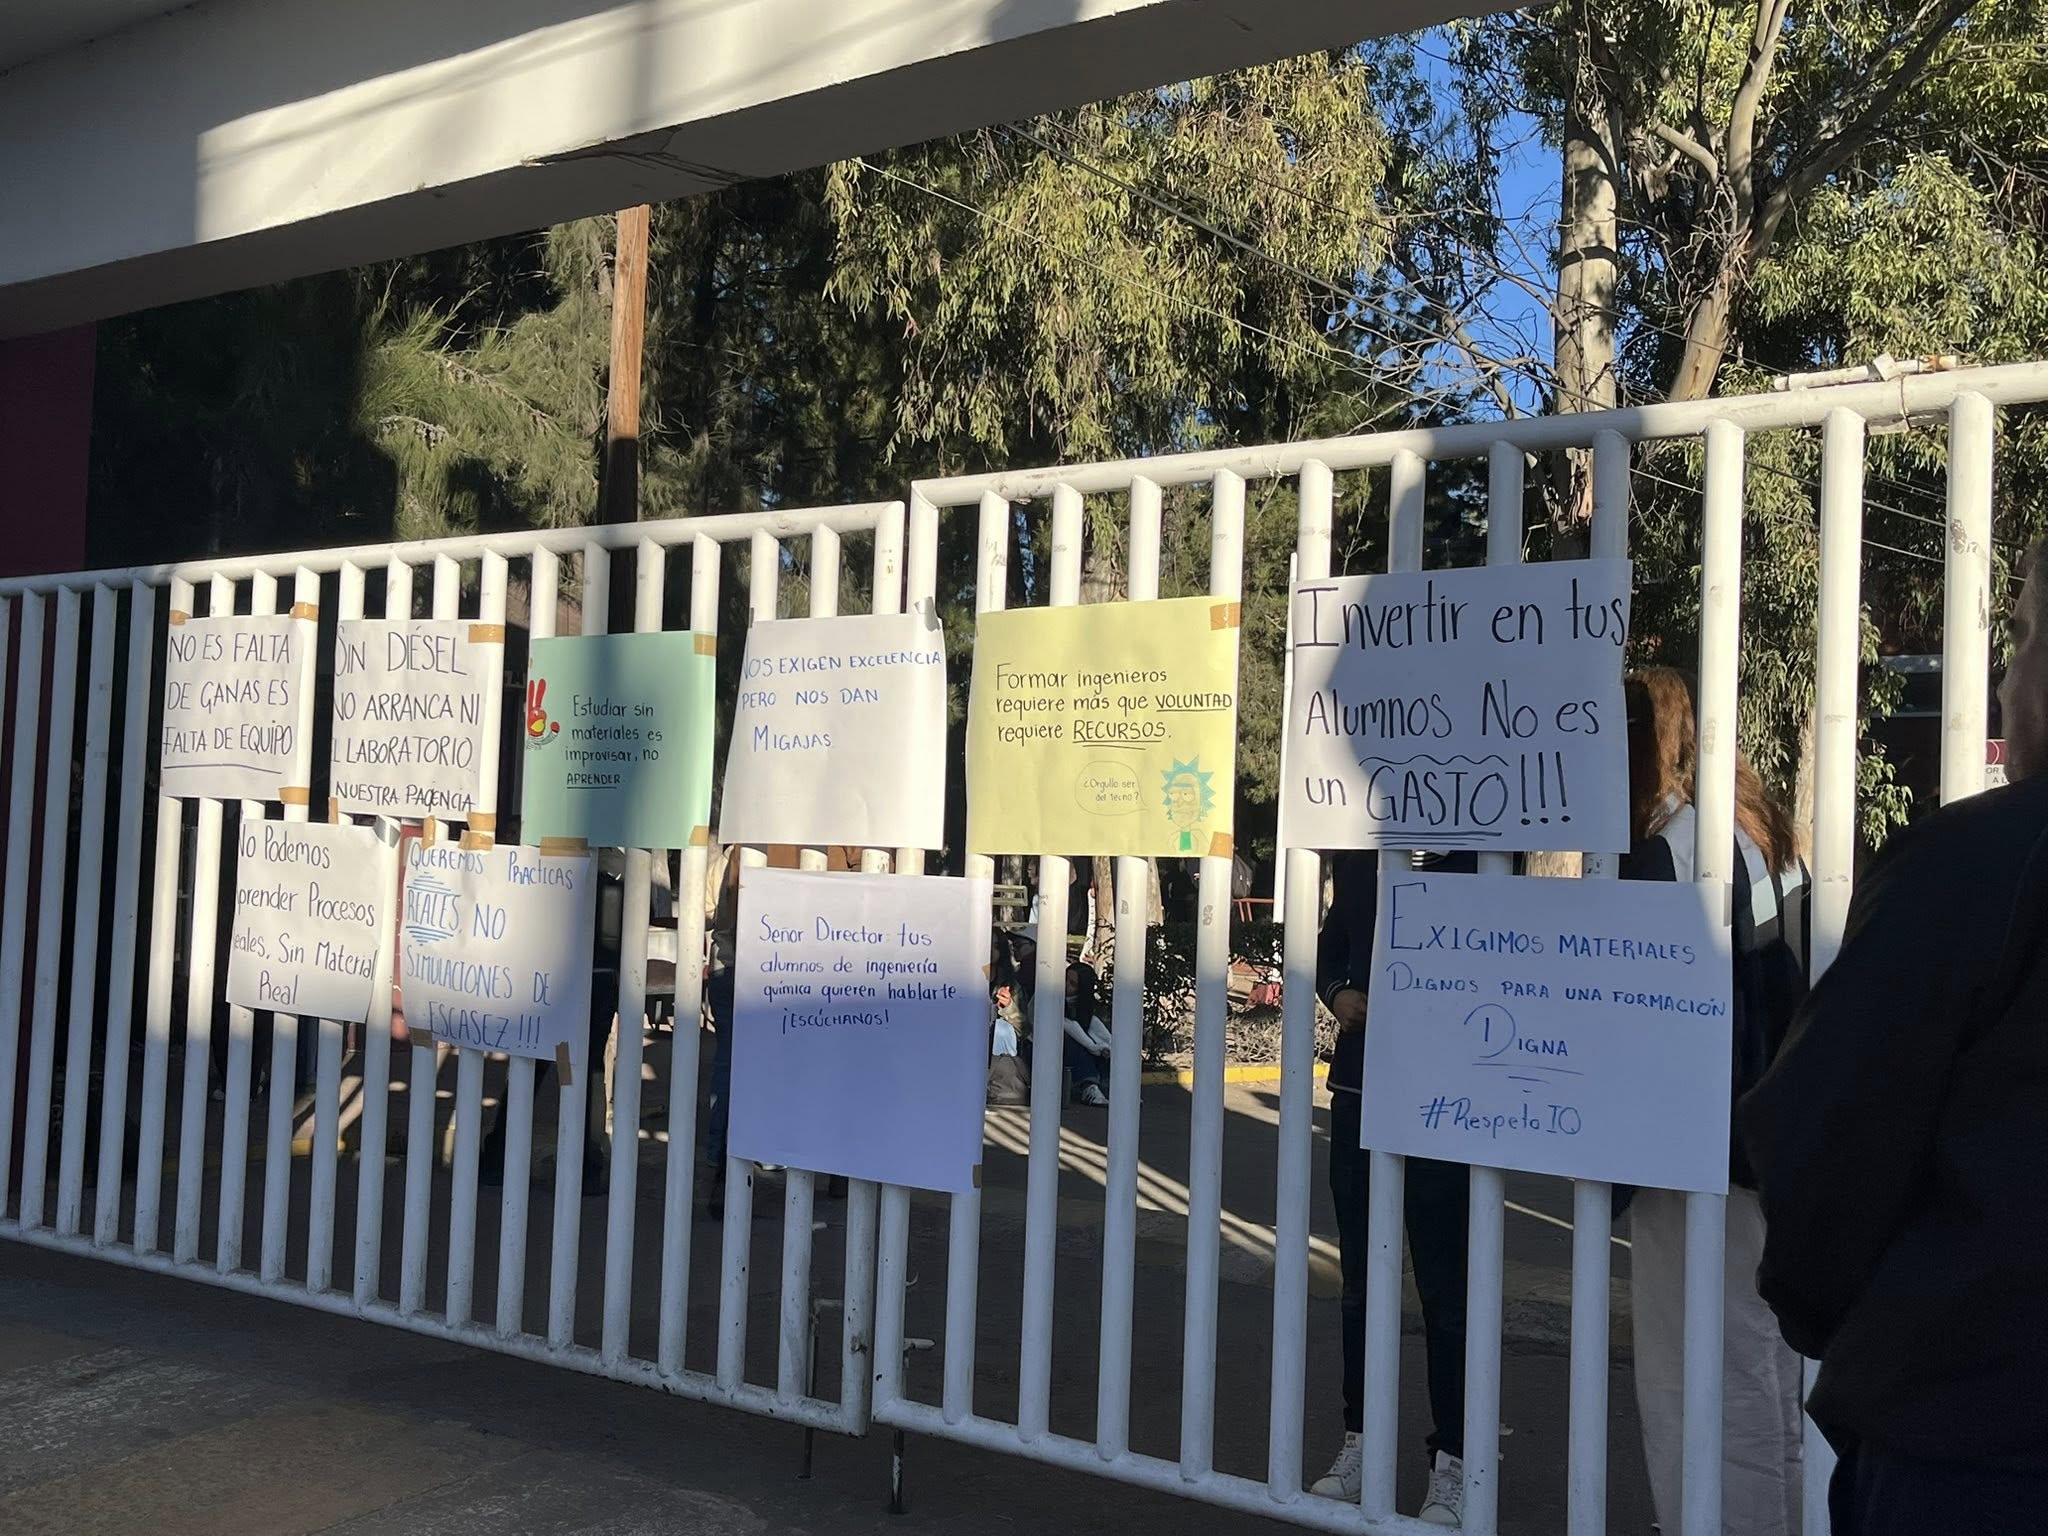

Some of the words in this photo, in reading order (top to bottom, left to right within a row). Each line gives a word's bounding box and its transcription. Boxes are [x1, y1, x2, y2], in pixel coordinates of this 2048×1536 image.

[1296, 580, 1468, 650] Invertir
[1492, 604, 1543, 645] en
[1565, 578, 1625, 646] tus
[169, 634, 196, 663] NO
[202, 634, 222, 661] ES
[234, 633, 290, 664] FALTA
[336, 626, 365, 676] SIN
[388, 626, 467, 675] DIÉSEL
[780, 656, 841, 674] EXIGEN
[850, 651, 941, 667] EXCELENCIA
[997, 663, 1067, 691] Formar
[1077, 670, 1167, 695] ingenieros
[168, 682, 192, 710] DE
[201, 679, 260, 714] GANAS
[268, 680, 288, 705] ES
[363, 693, 453, 721] ARRANCA
[461, 693, 479, 725] NI
[573, 695, 627, 717] Estudiar
[635, 703, 653, 717] sin
[742, 691, 776, 710] PERO
[796, 690, 828, 705] NOS
[840, 688, 879, 705] DAN
[997, 696, 1065, 720] requiere
[1073, 695, 1109, 711] más
[1117, 695, 1148, 716] que
[1156, 693, 1232, 708] VOLUNTAD
[1305, 689, 1452, 738] Alumnos
[1482, 680, 1538, 738] No
[1556, 700, 1600, 734] es
[163, 727, 206, 755] FALTA
[214, 728, 234, 749] DE
[240, 720, 293, 755] EQUIPO
[572, 725, 639, 740] materiales
[648, 729, 662, 741] es
[998, 723, 1063, 747] requiere
[565, 746, 638, 767] improvisar,
[643, 749, 659, 760] no
[336, 781, 399, 806] NUESTRA
[567, 772, 621, 785] APRENDER
[1305, 777, 1346, 806] un
[1095, 792, 1107, 801] del
[265, 825, 330, 869] Podemos
[410, 842, 483, 874] QUEREMOS
[237, 884, 298, 916] prender
[309, 882, 374, 927] Procesos
[473, 904, 506, 940] NO
[759, 914, 804, 944] Señor
[816, 916, 883, 944] Director
[898, 923, 932, 947] tus
[1391, 882, 1544, 954] EXIGIMOS
[1559, 934, 1696, 964] MATERIALES
[234, 928, 270, 959] eales,
[278, 933, 304, 963] Sin
[315, 941, 377, 980] Material
[760, 952, 824, 973] alumnos
[833, 956, 853, 972] de
[866, 957, 937, 979] ingeniería
[406, 945, 513, 1000] SIMULACIONES
[534, 971, 551, 1006] DE
[764, 981, 811, 1002] química
[822, 983, 876, 1004] quieren
[1501, 981, 1549, 998] PARA
[1566, 988, 1602, 1001] UNA
[1612, 990, 1726, 1016] FORMACIÓN
